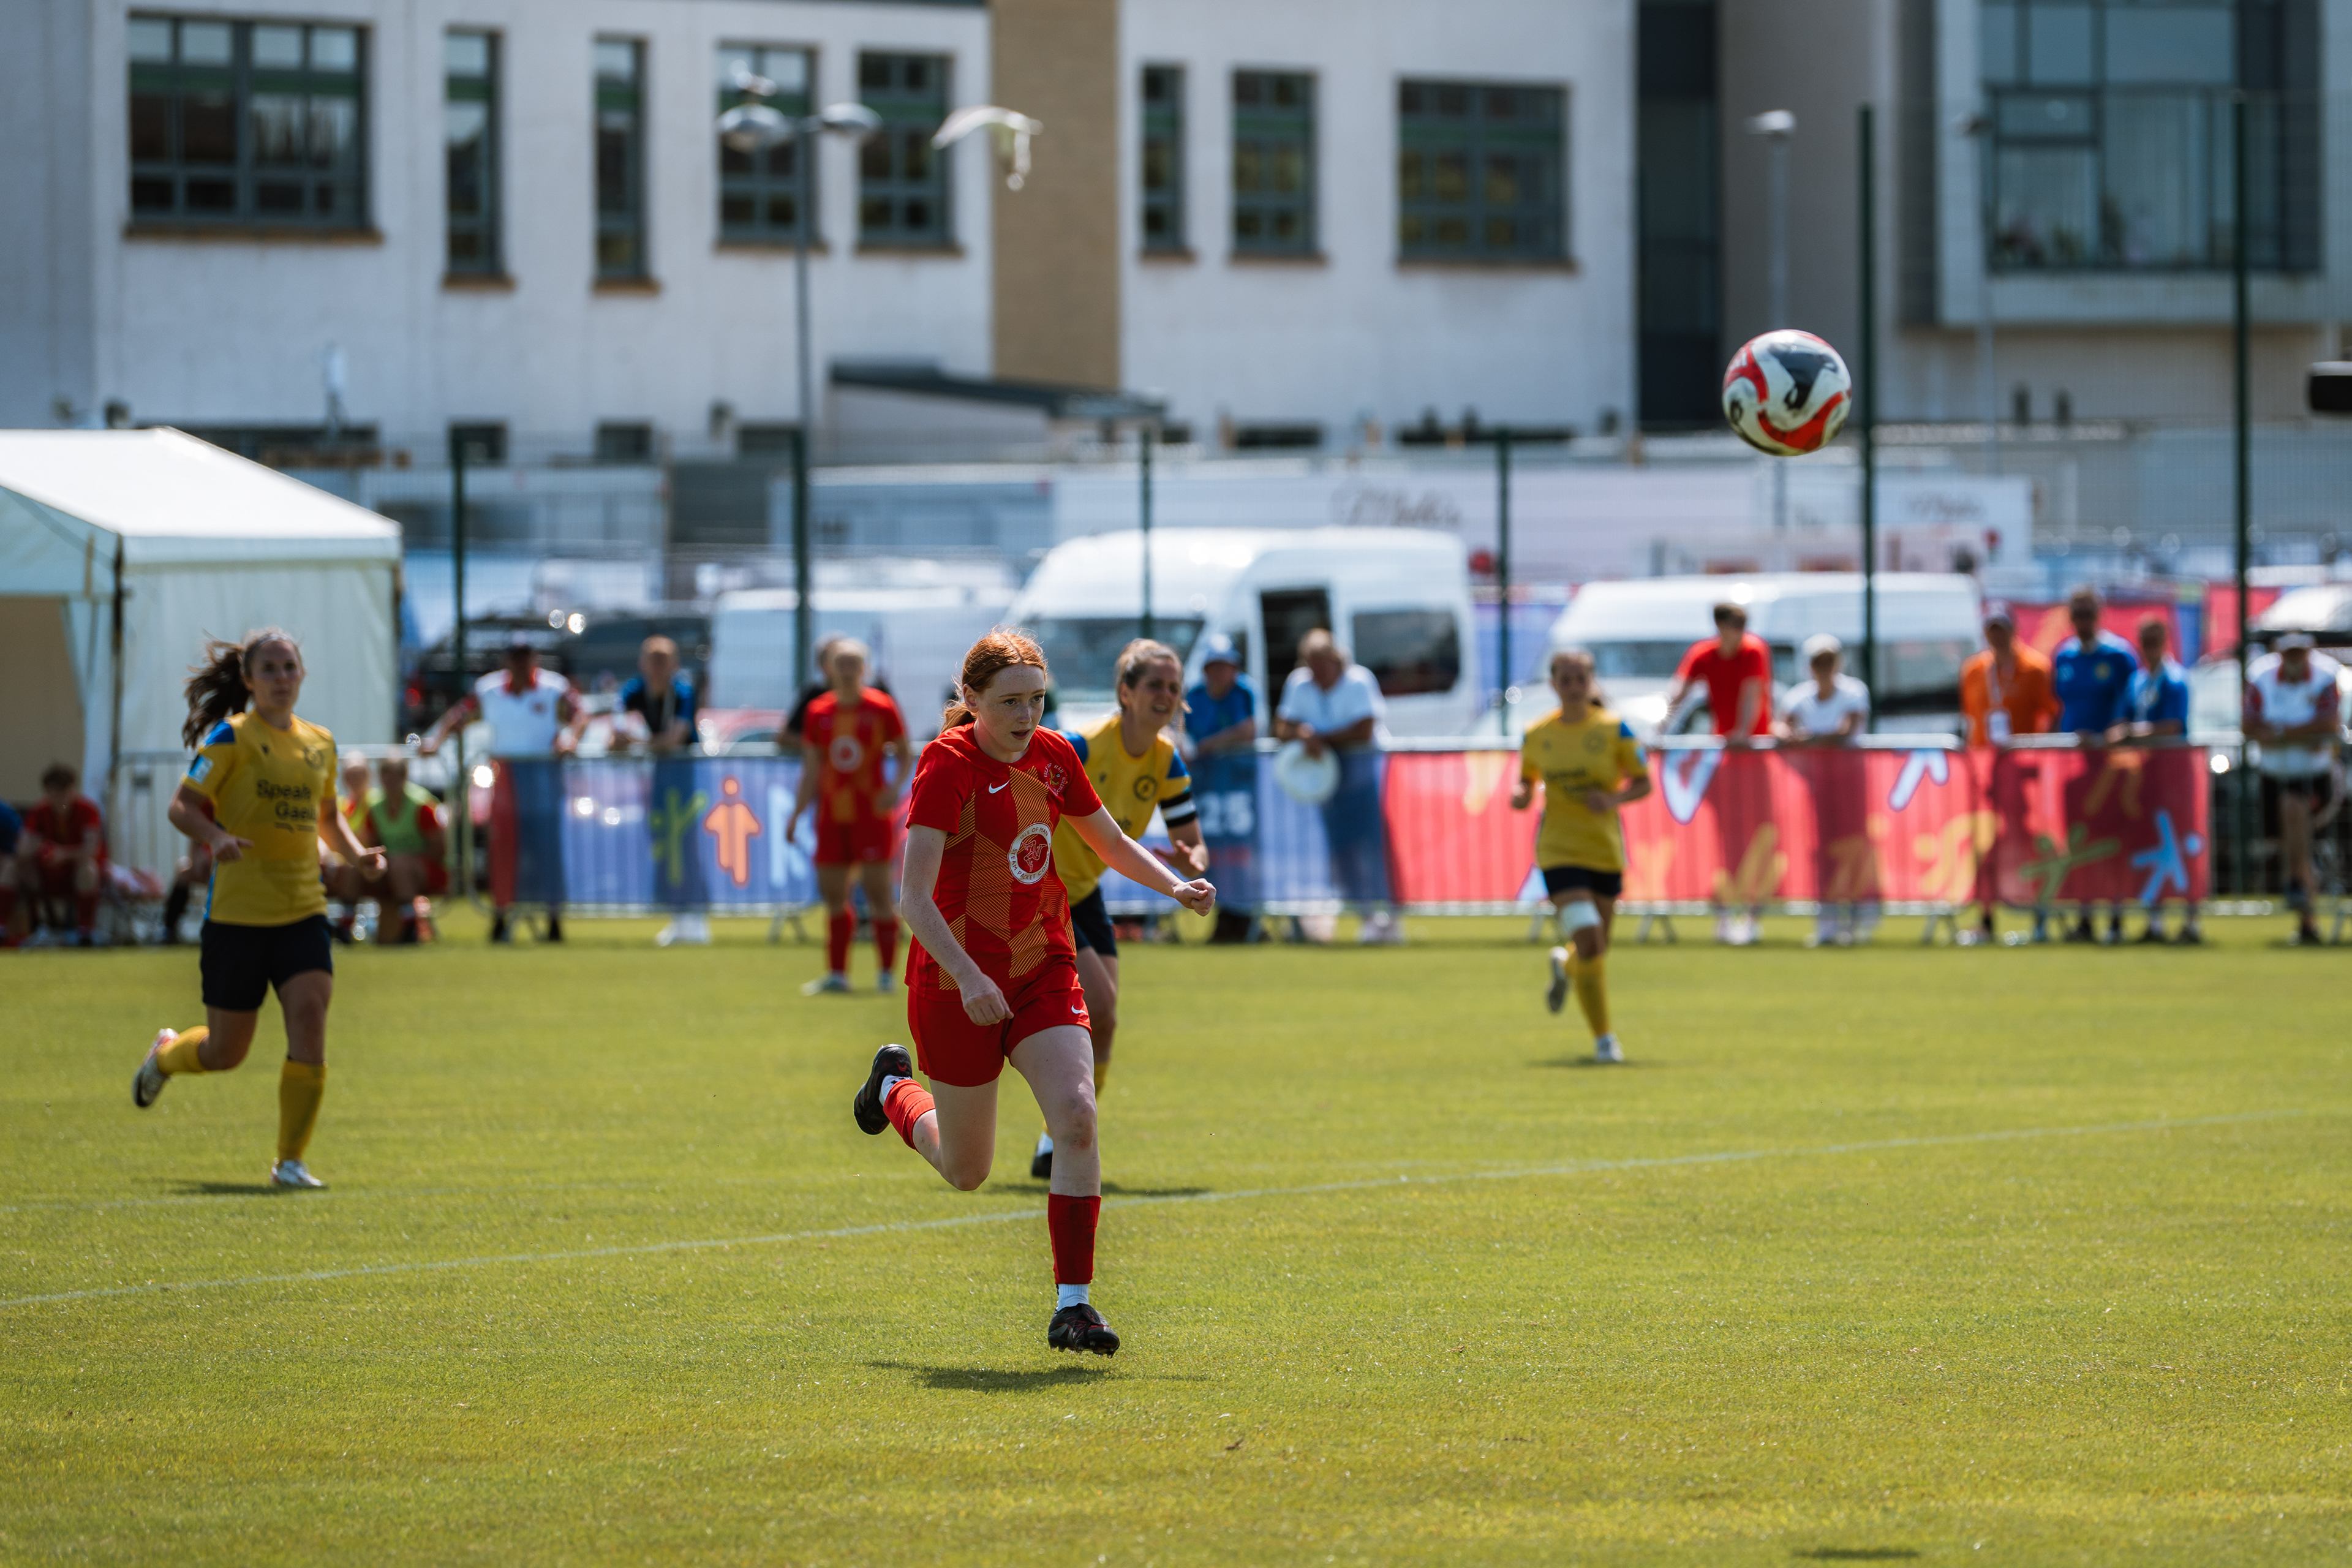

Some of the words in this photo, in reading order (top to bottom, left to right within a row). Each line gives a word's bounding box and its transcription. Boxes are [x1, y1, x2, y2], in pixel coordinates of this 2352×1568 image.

[1054, 764, 1065, 774] MAN
[1020, 831, 1030, 840] ISLE
[1039, 827, 1049, 837] MAN
[1017, 870, 1036, 880] PACKET
